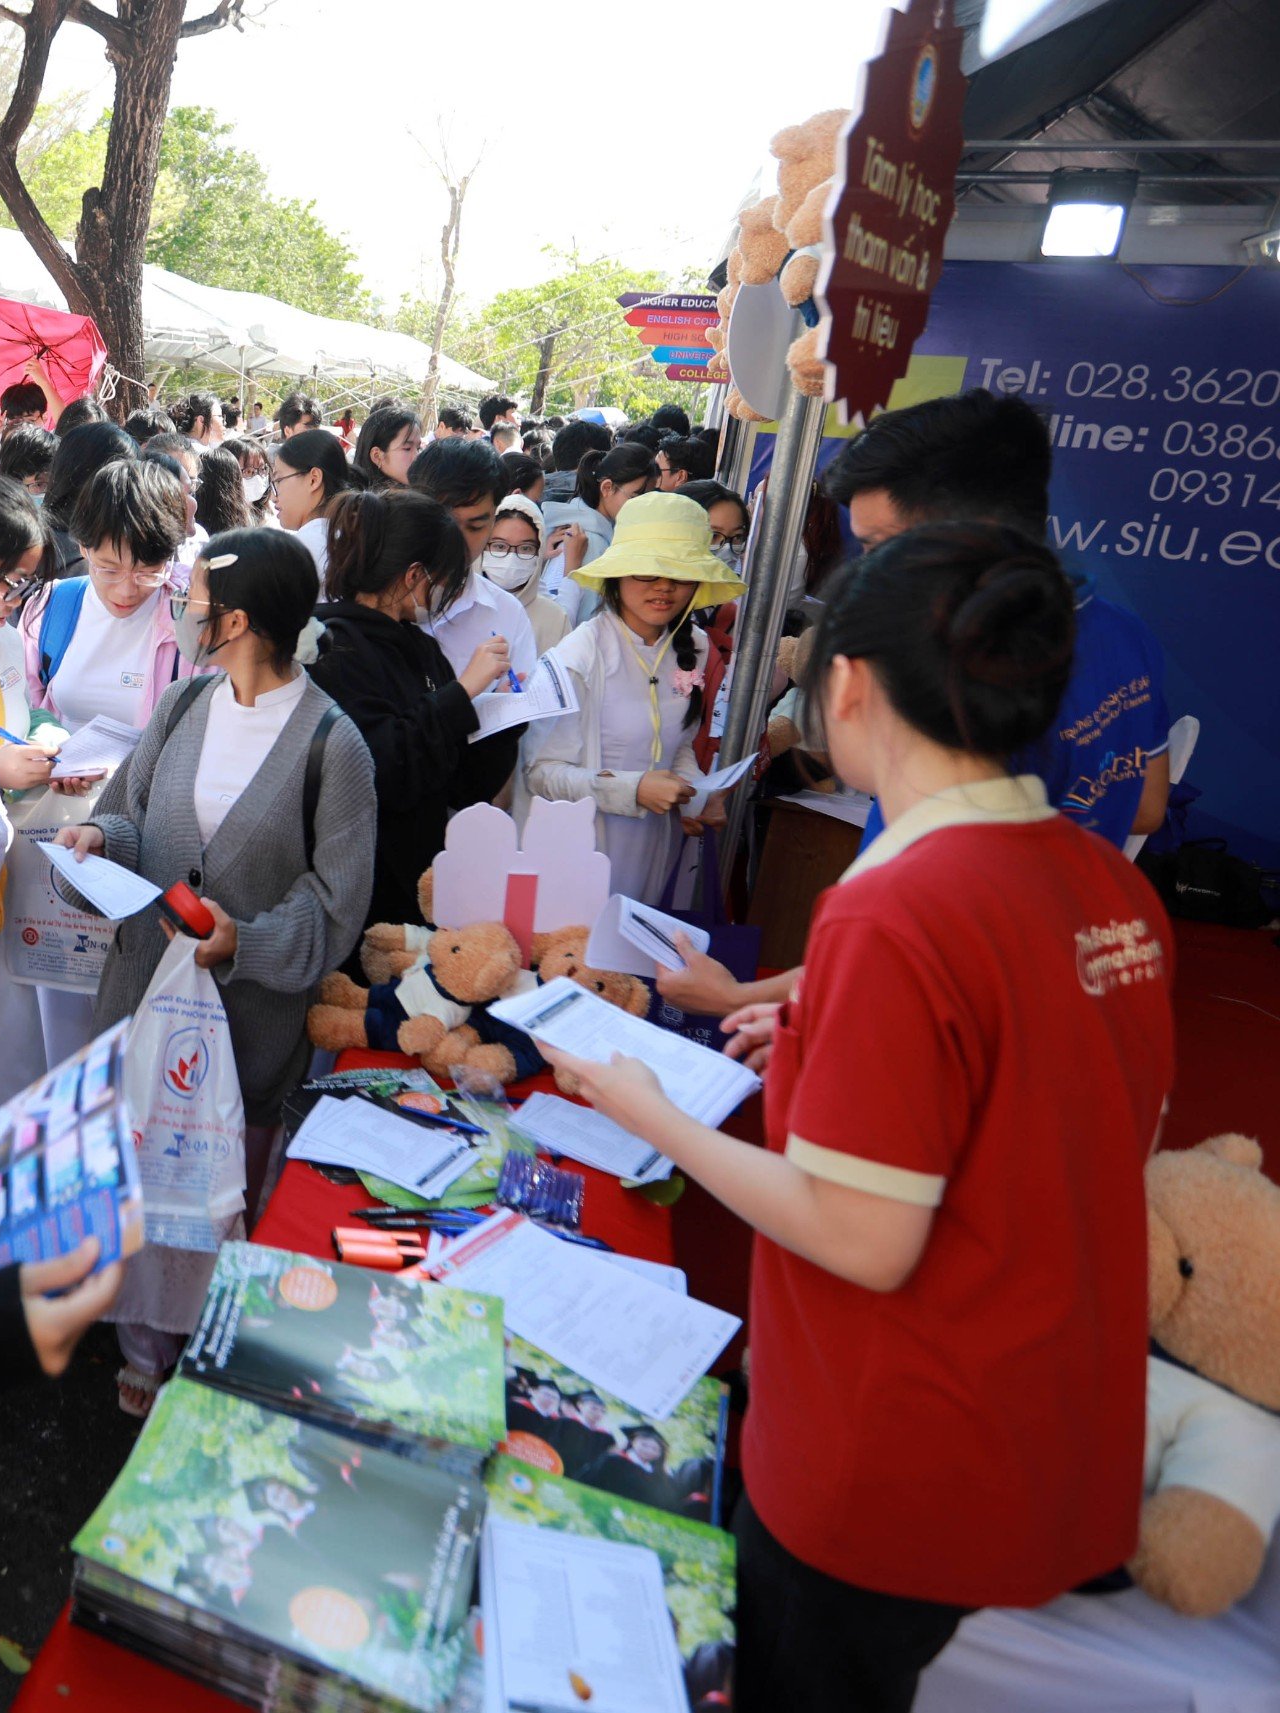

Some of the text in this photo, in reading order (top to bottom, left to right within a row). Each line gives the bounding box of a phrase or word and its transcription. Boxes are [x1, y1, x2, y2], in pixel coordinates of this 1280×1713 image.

[640, 297, 719, 309] HIGHER EDUCA
[647, 315, 691, 325] ENGLISH
[663, 332, 688, 341] HIGH
[669, 351, 714, 360] UNIVERS
[679, 369, 729, 379] COLLEGE
[980, 358, 1280, 407] Tel: 028.3620
[1048, 413, 1280, 461] line: 0386
[1047, 513, 1280, 570] w.siu.e
